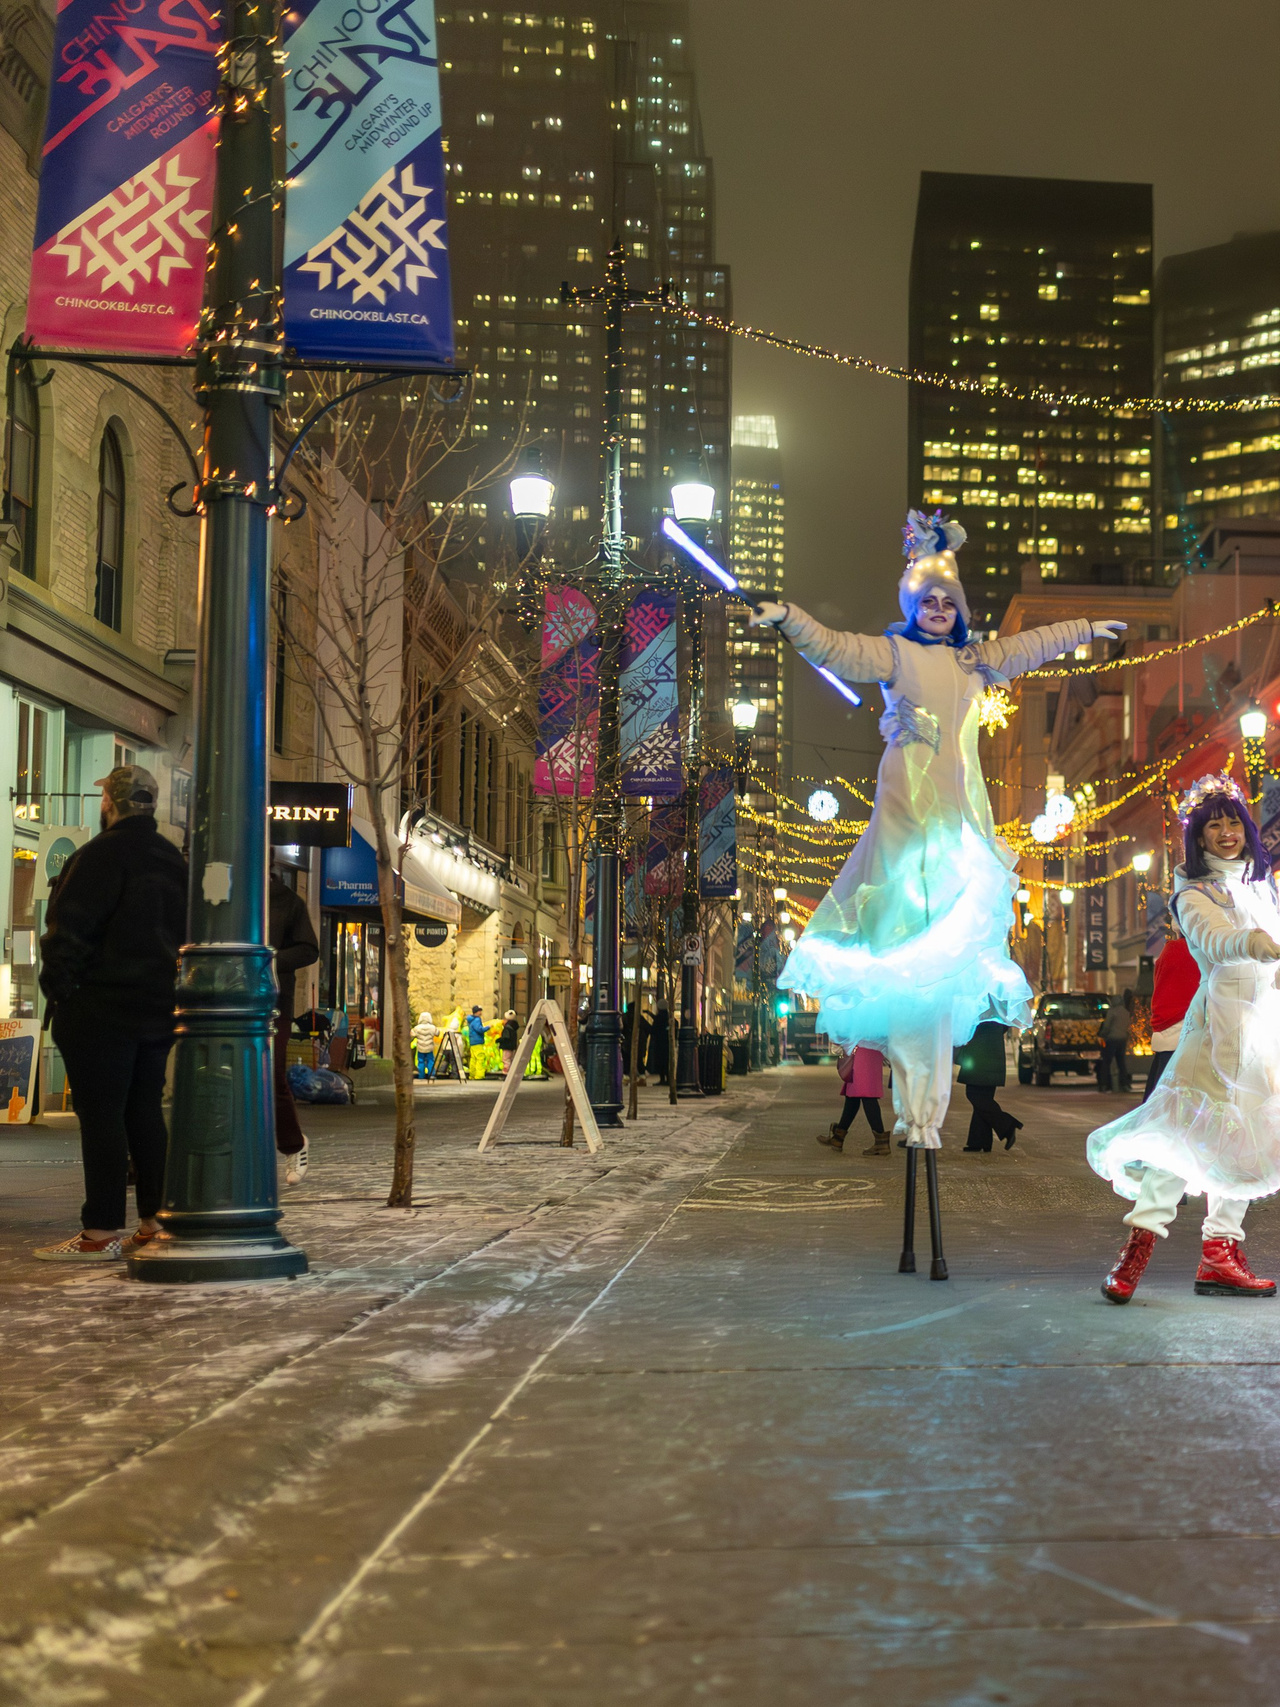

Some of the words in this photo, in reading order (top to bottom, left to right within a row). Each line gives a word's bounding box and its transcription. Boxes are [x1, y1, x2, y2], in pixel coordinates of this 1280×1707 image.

[293, 0, 389, 92] CHINOO
[124, 86, 194, 140] MIDWINTER
[150, 102, 197, 139] ROUND
[195, 89, 212, 109] UP
[344, 93, 399, 151] CALGARY'S
[359, 97, 418, 154] MIDWINTER
[381, 114, 421, 149] ROUND
[421, 102, 432, 119] UP
[55, 296, 175, 315] CHINOOKBLAST.CA
[309, 308, 430, 325] CHINOOKBLAST.CA
[338, 881, 373, 890] Pharma
